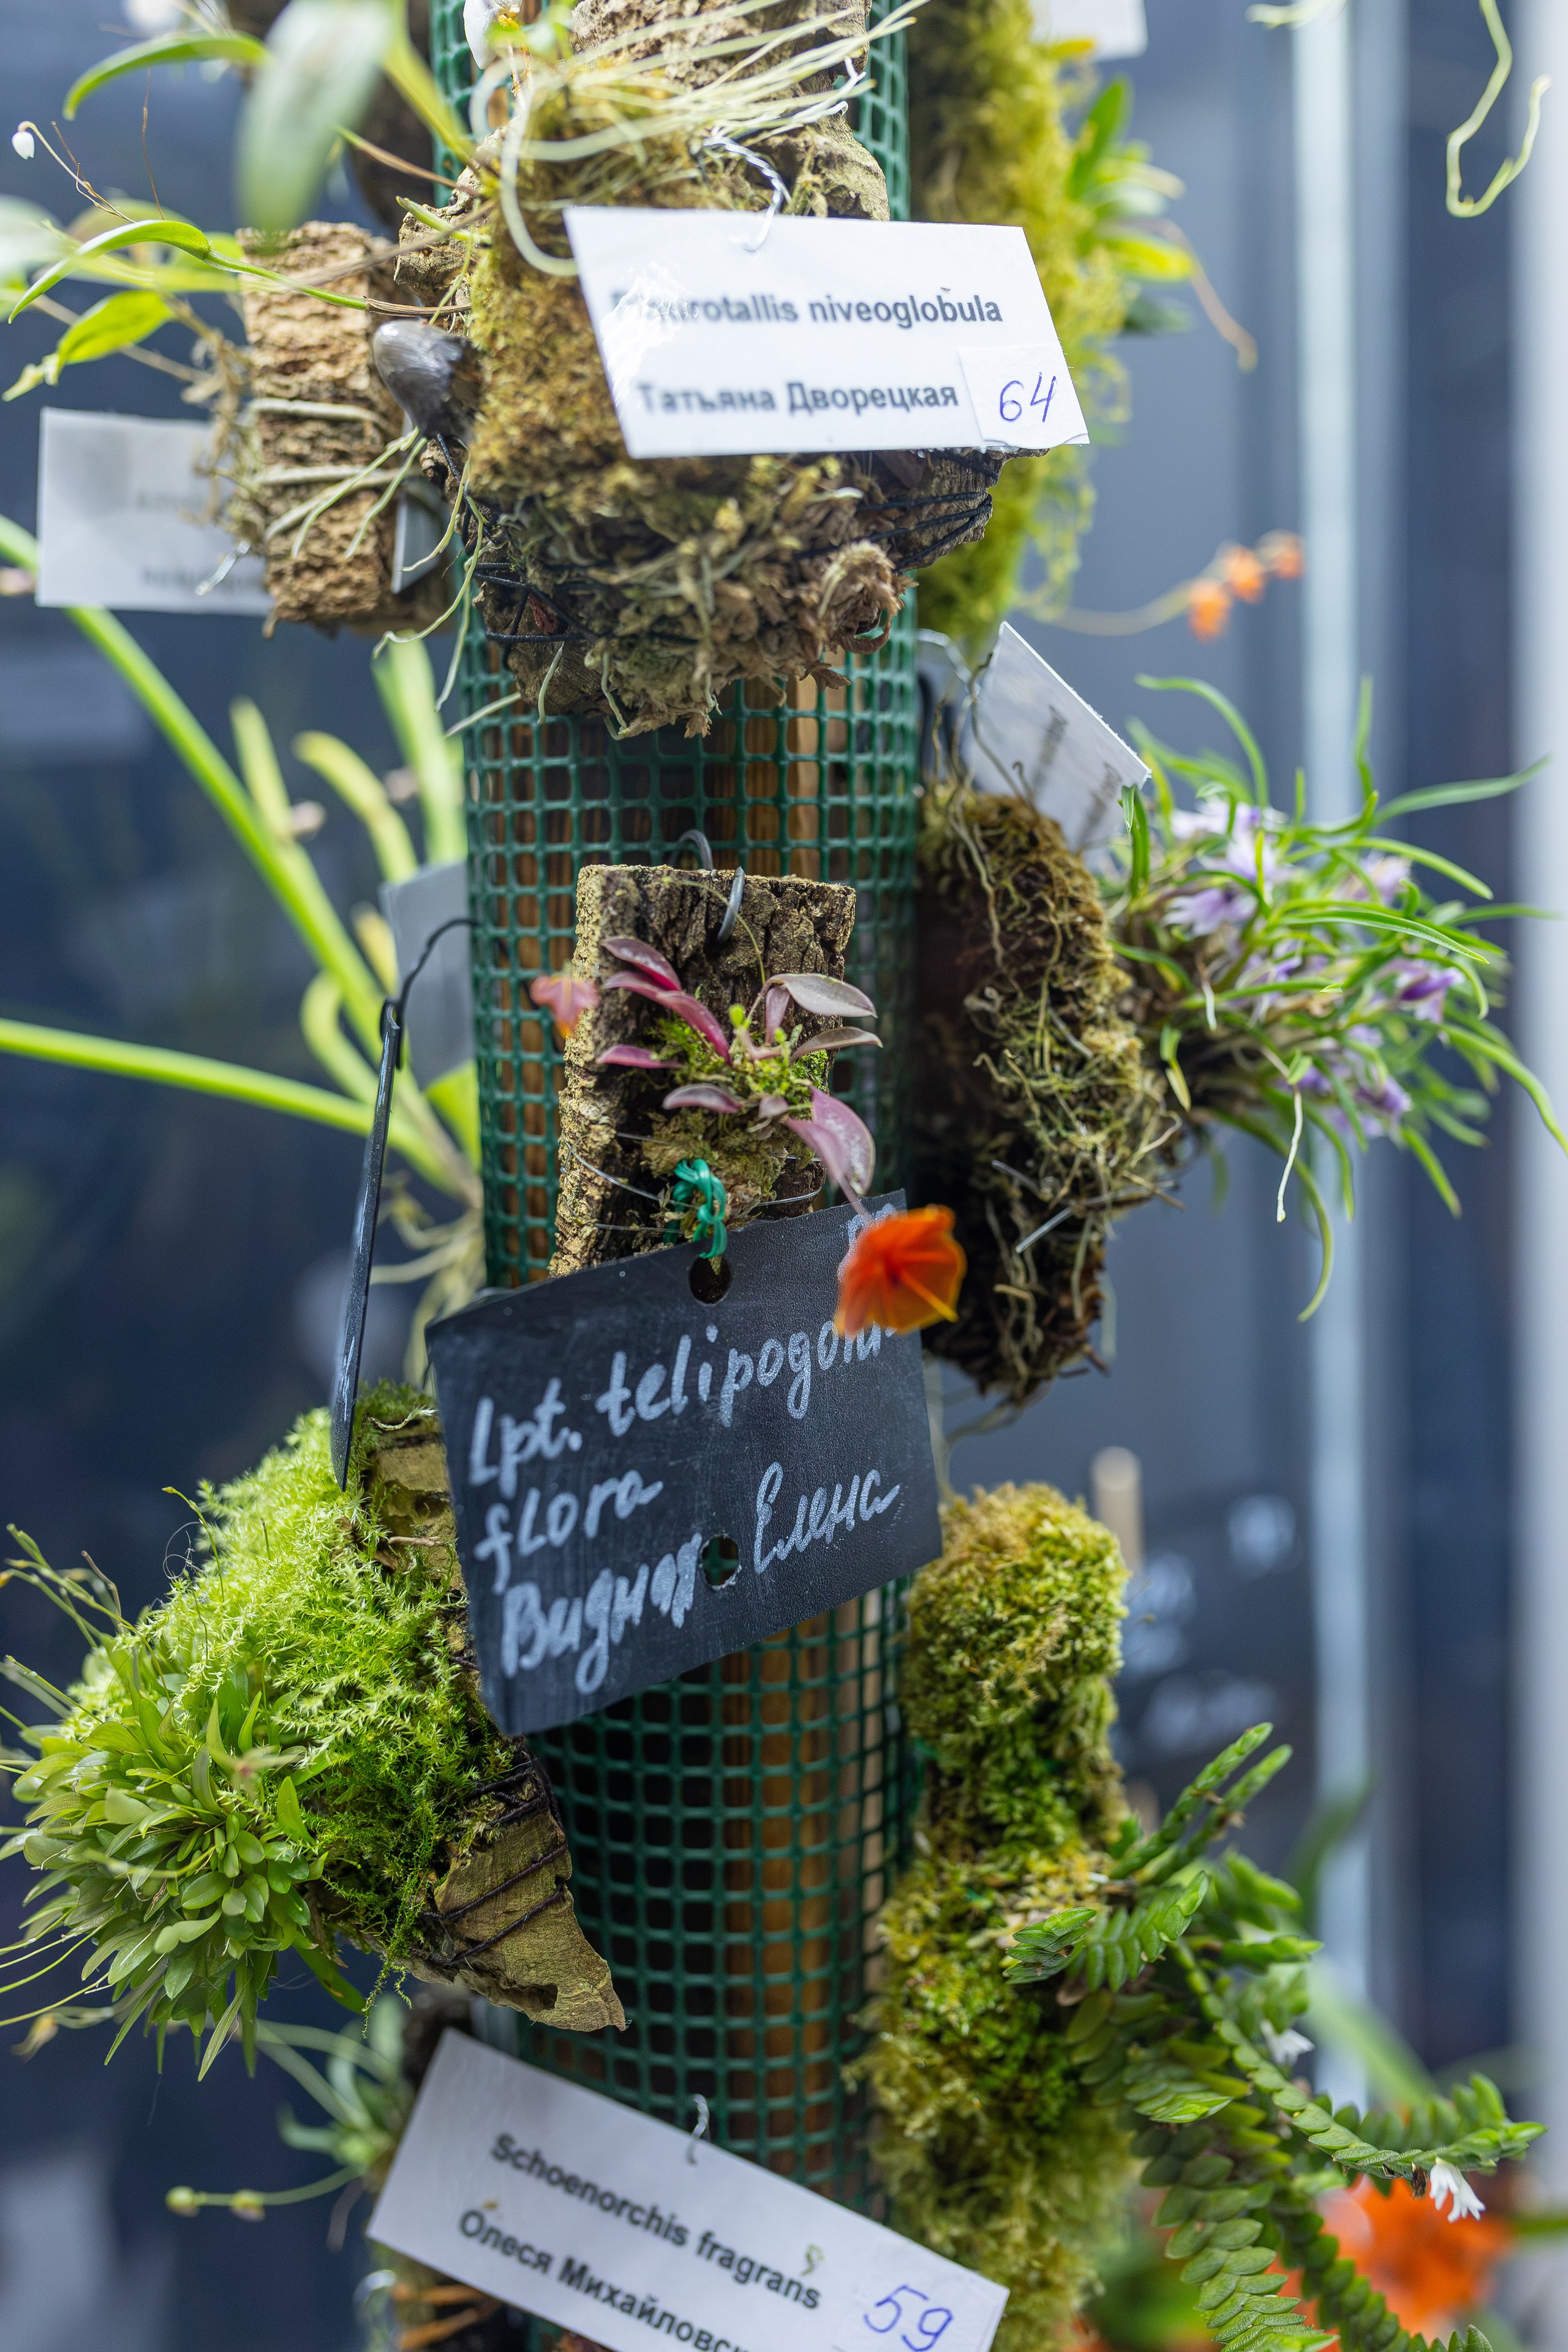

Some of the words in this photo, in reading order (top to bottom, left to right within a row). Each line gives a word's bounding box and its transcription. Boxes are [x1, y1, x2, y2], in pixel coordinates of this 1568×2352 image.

[611, 291, 798, 322] rotallis
[807, 294, 1003, 329] niveoglobula
[638, 380, 774, 412] Татьяна
[785, 382, 959, 416] Дворецкая
[999, 372, 1058, 423] 64
[754, 1461, 901, 1574] Елена
[492, 2133, 689, 2247] Schoenorchis
[696, 2230, 821, 2310] fragrans
[459, 2209, 552, 2274] Олеся
[557, 2256, 750, 2351] Михайловс
[863, 2283, 954, 2351] 59
